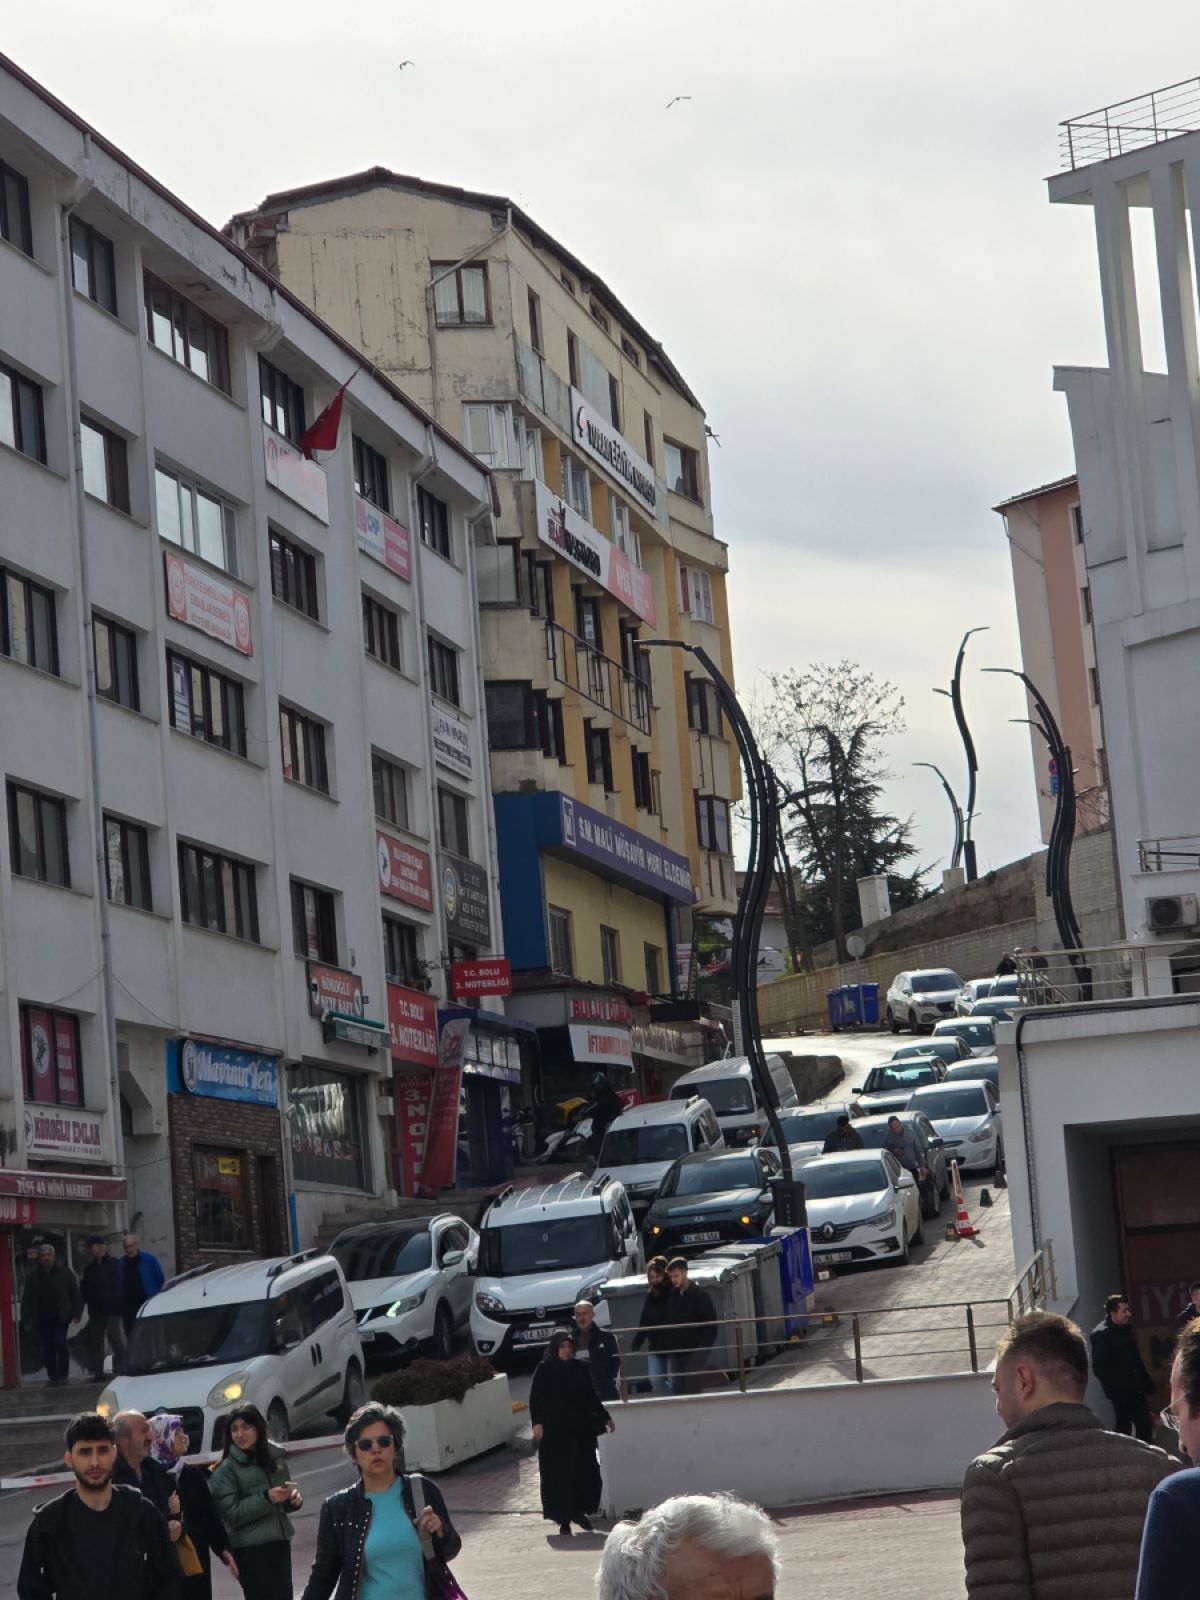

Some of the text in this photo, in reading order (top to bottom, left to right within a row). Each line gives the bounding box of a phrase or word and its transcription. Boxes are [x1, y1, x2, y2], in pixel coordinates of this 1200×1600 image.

[594, 825, 614, 853] MALİ
[479, 968, 500, 976] BOLU
[465, 976, 509, 989] NOTERLİĞİ
[410, 1003, 425, 1022] BOLU
[391, 1023, 398, 1045] 3.
[399, 1025, 437, 1055] NOTERLİĞİ
[34, 1111, 71, 1143] KÖROĞLU
[65, 1183, 93, 1198] MARKET
